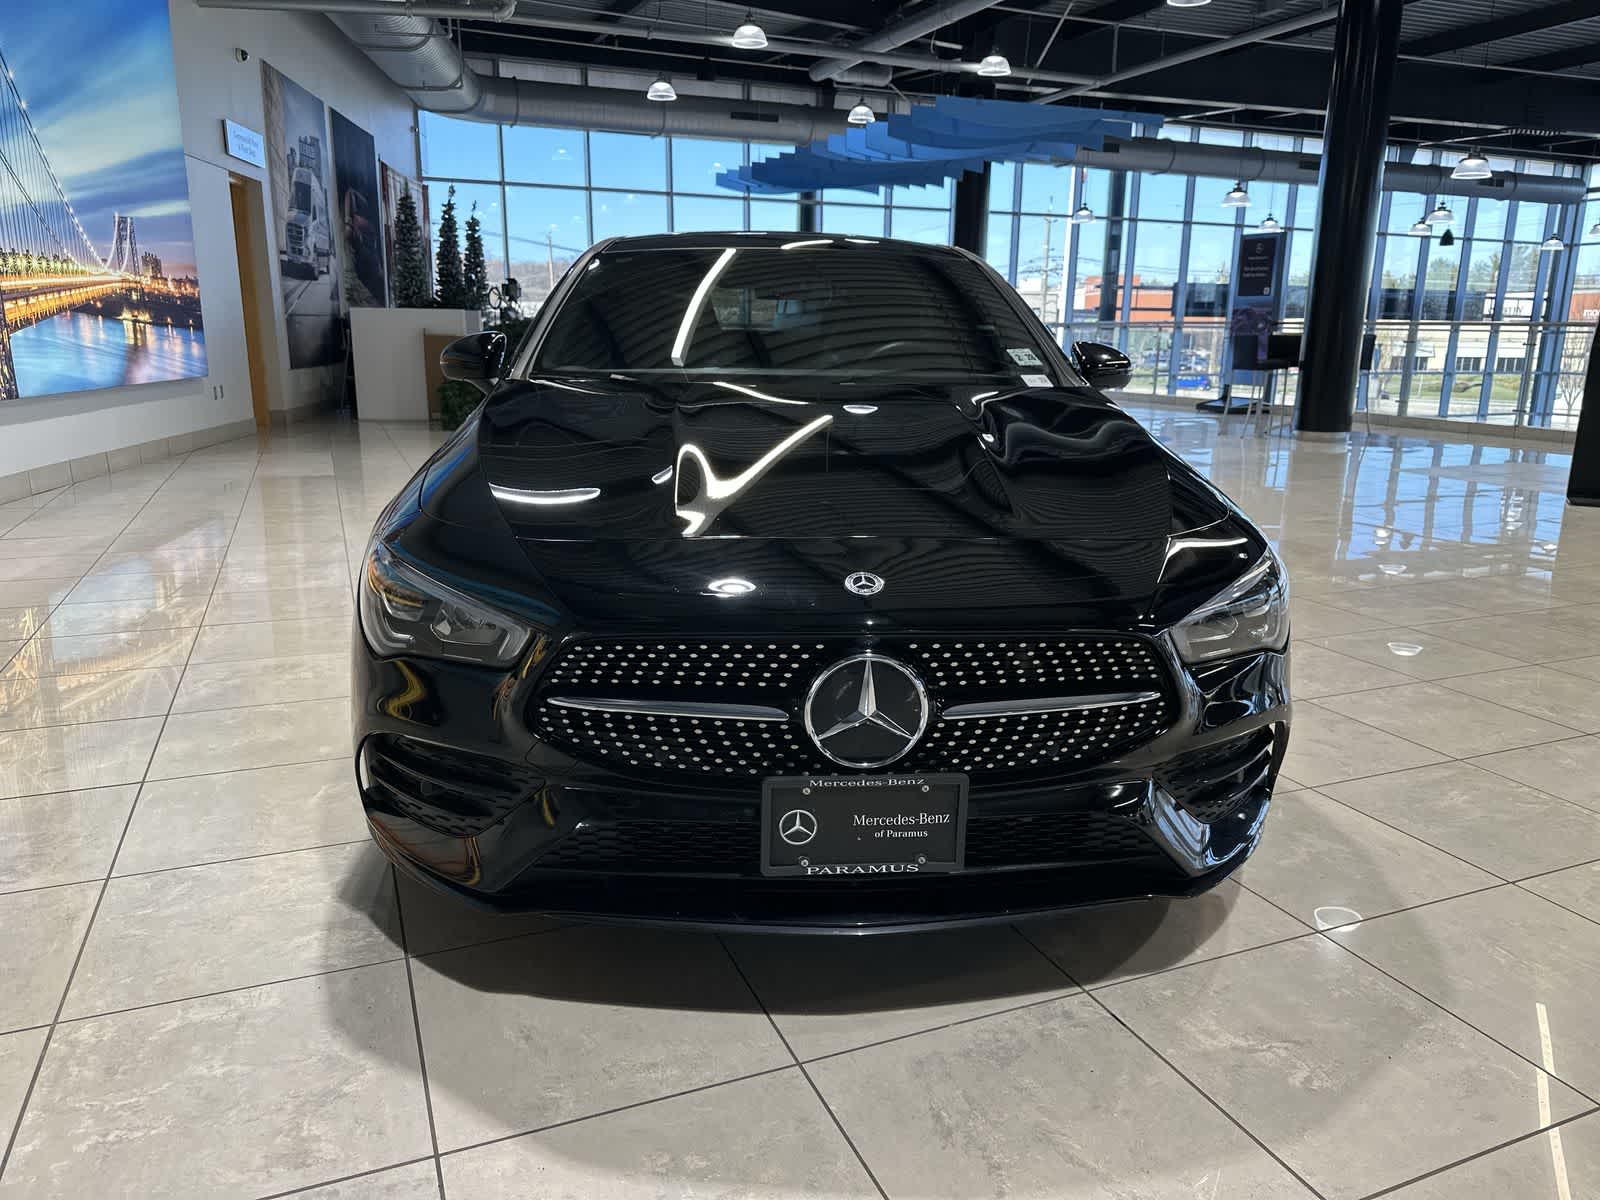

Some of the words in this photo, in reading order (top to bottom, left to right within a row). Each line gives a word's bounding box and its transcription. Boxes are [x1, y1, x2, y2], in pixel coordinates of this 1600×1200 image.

[809, 778, 925, 787] Mercedes-Benz
[853, 812, 950, 826] Mercedes-Benz
[874, 829, 884, 838] of
[886, 829, 928, 838] Paramus
[806, 863, 920, 875] PARAMUS
